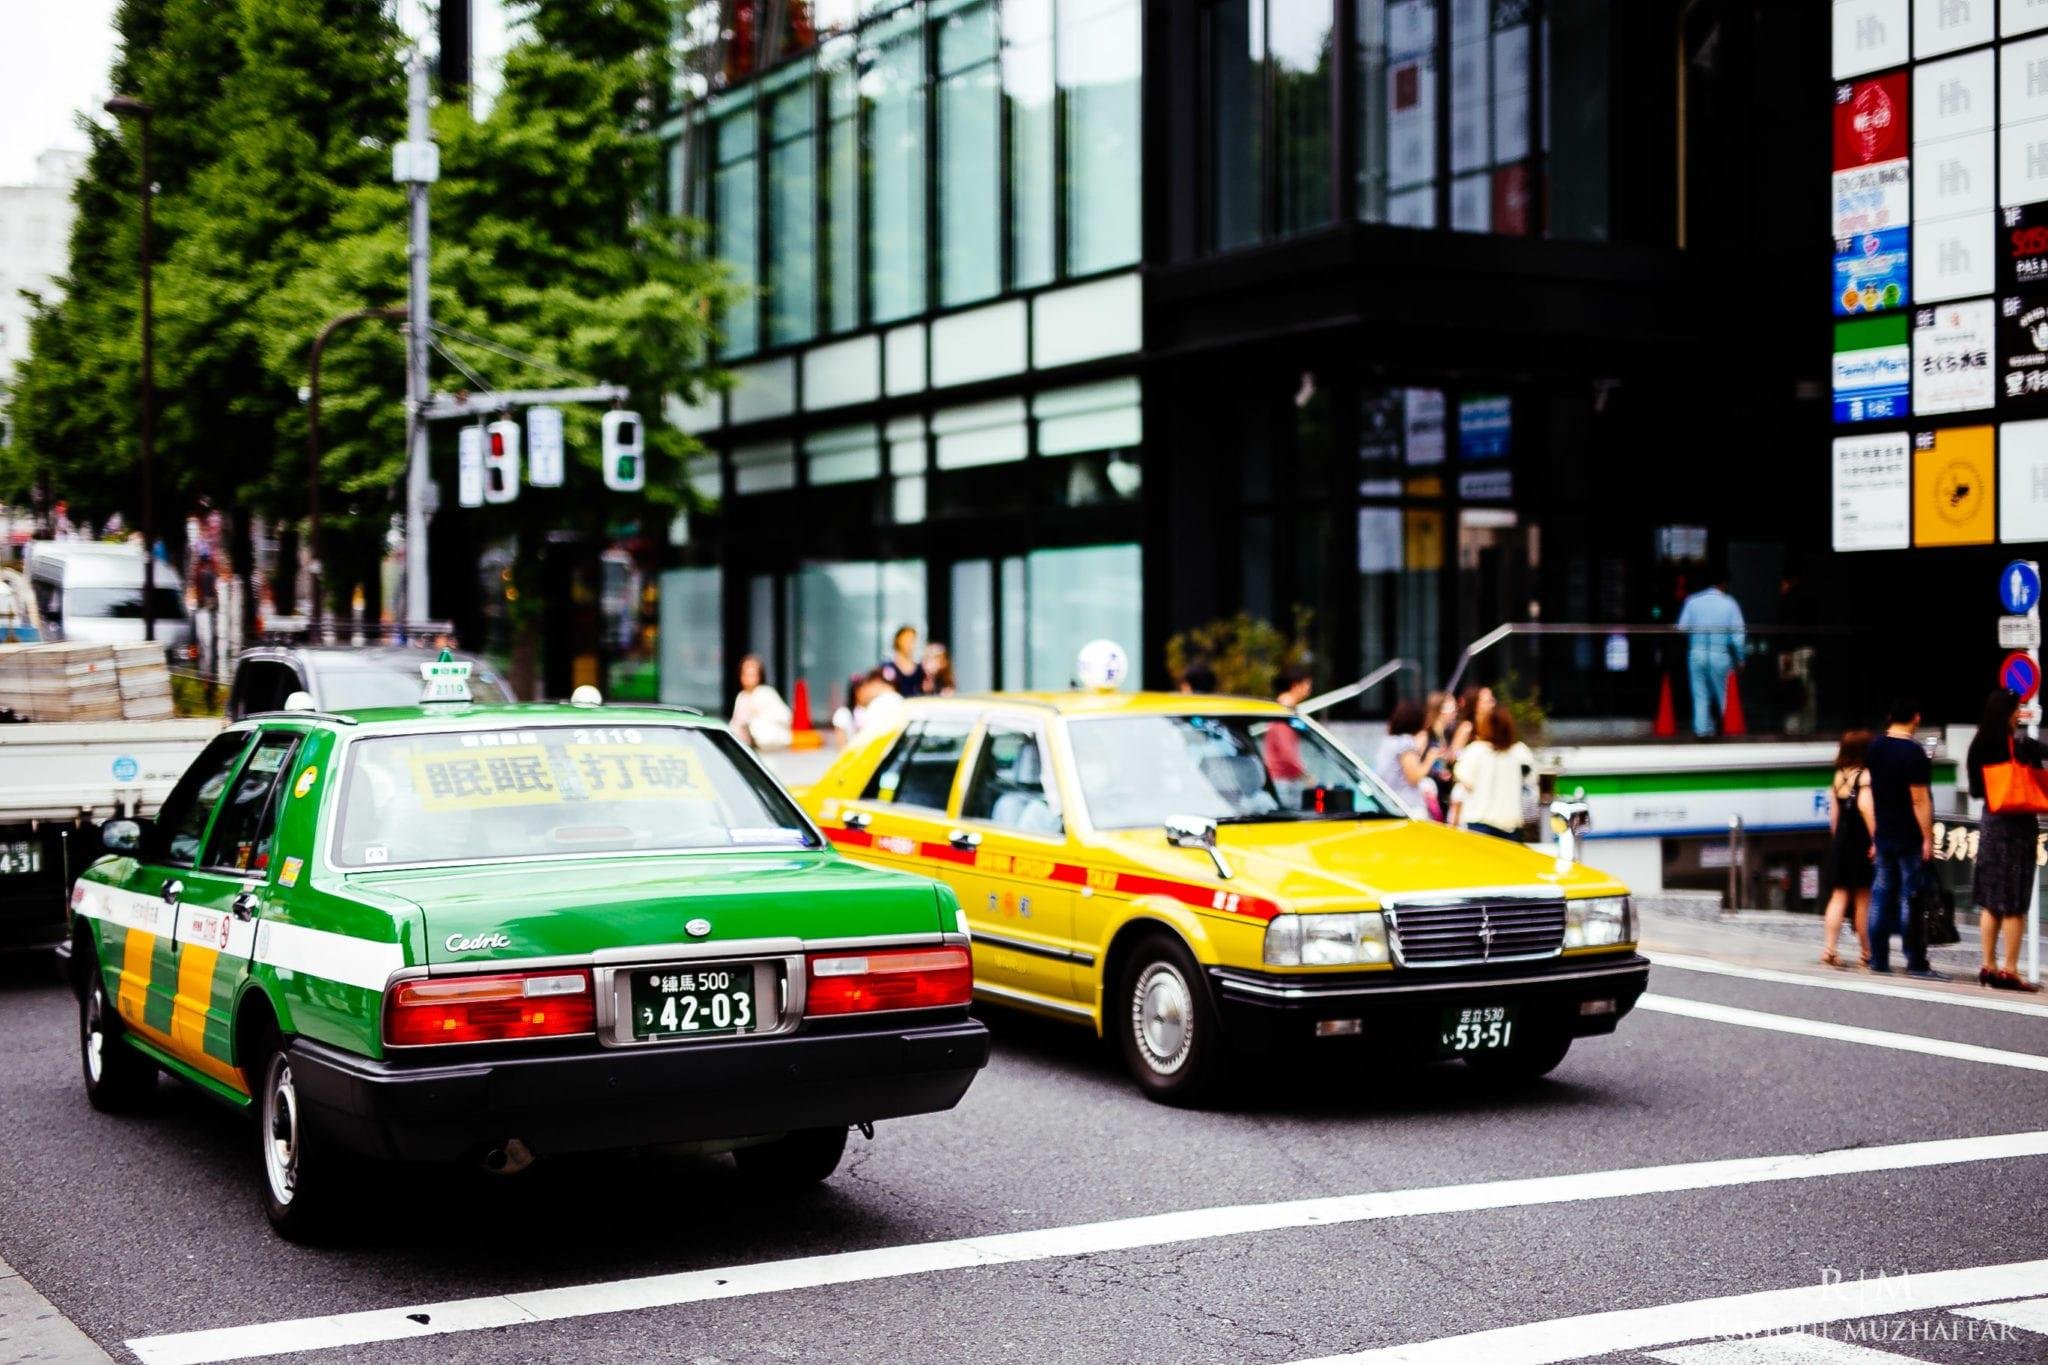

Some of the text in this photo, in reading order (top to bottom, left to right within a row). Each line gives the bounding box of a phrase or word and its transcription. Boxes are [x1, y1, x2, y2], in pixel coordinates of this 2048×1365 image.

[445, 932, 511, 952] Cedric
[661, 971, 730, 993] 練馬 500
[643, 991, 751, 1031] う 42-03
